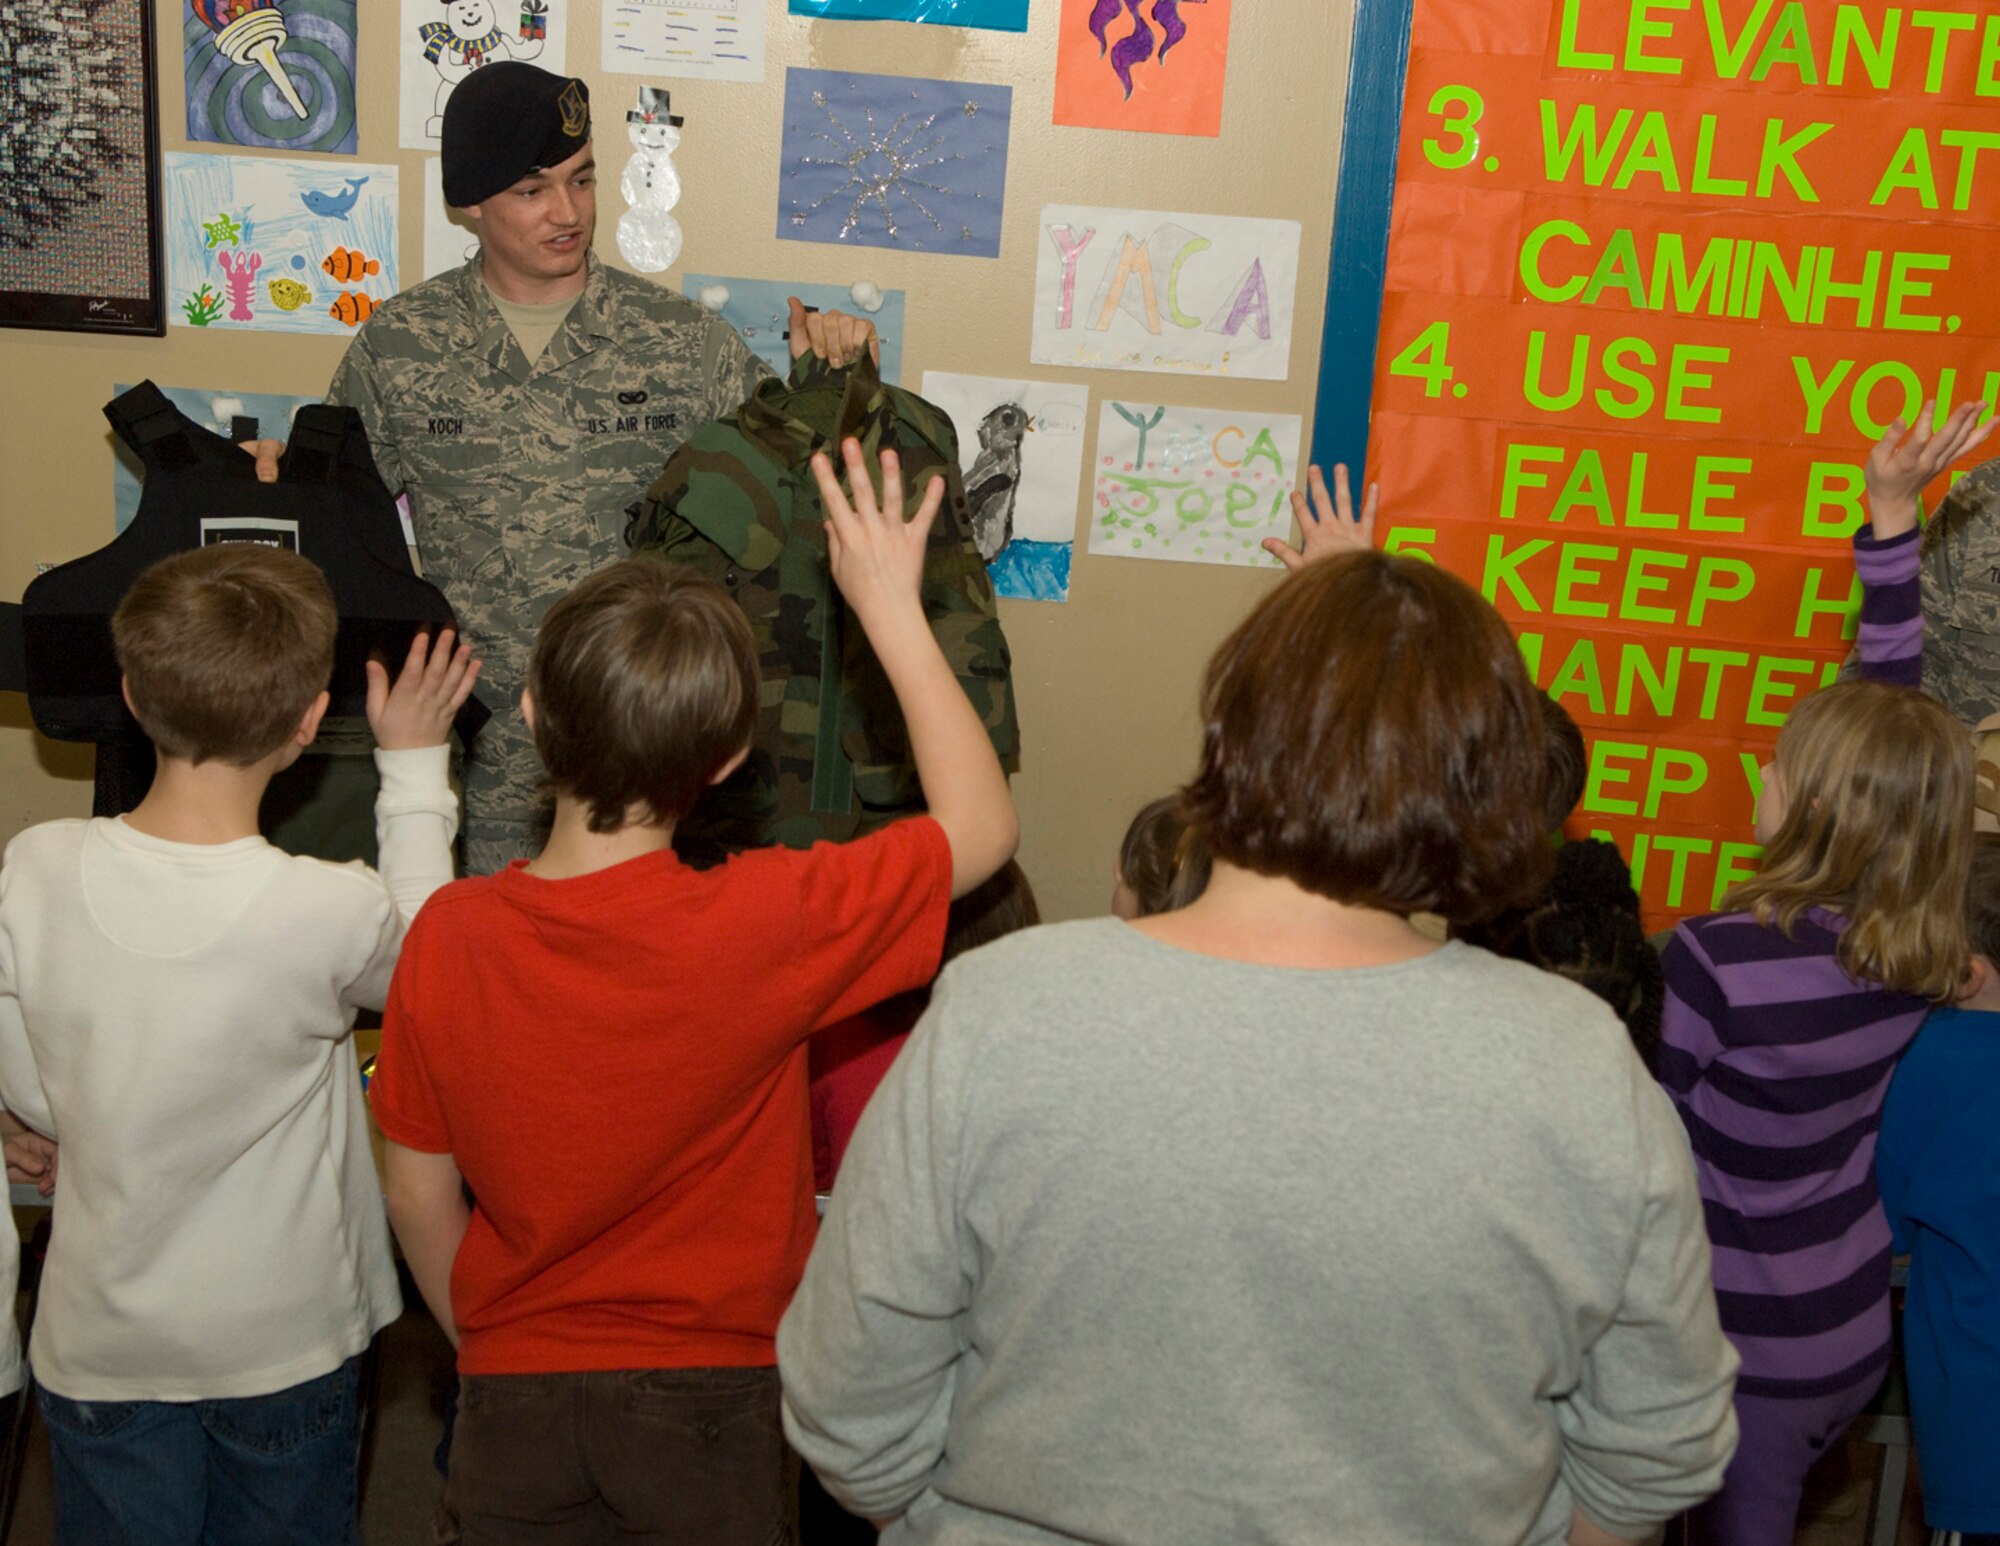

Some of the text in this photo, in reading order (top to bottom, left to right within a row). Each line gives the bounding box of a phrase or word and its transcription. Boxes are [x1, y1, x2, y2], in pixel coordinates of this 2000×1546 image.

[1423, 85, 2000, 210] 3. WALK AT
[1045, 223, 1271, 340] YMCA
[1390, 321, 1467, 398] 4.
[1523, 331, 1730, 423] USE
[427, 418, 463, 435] KOCH
[587, 413, 677, 434] U.S. AIR FORCE
[1500, 443, 1753, 533] FALE
[1480, 534, 1755, 627] KEEP
